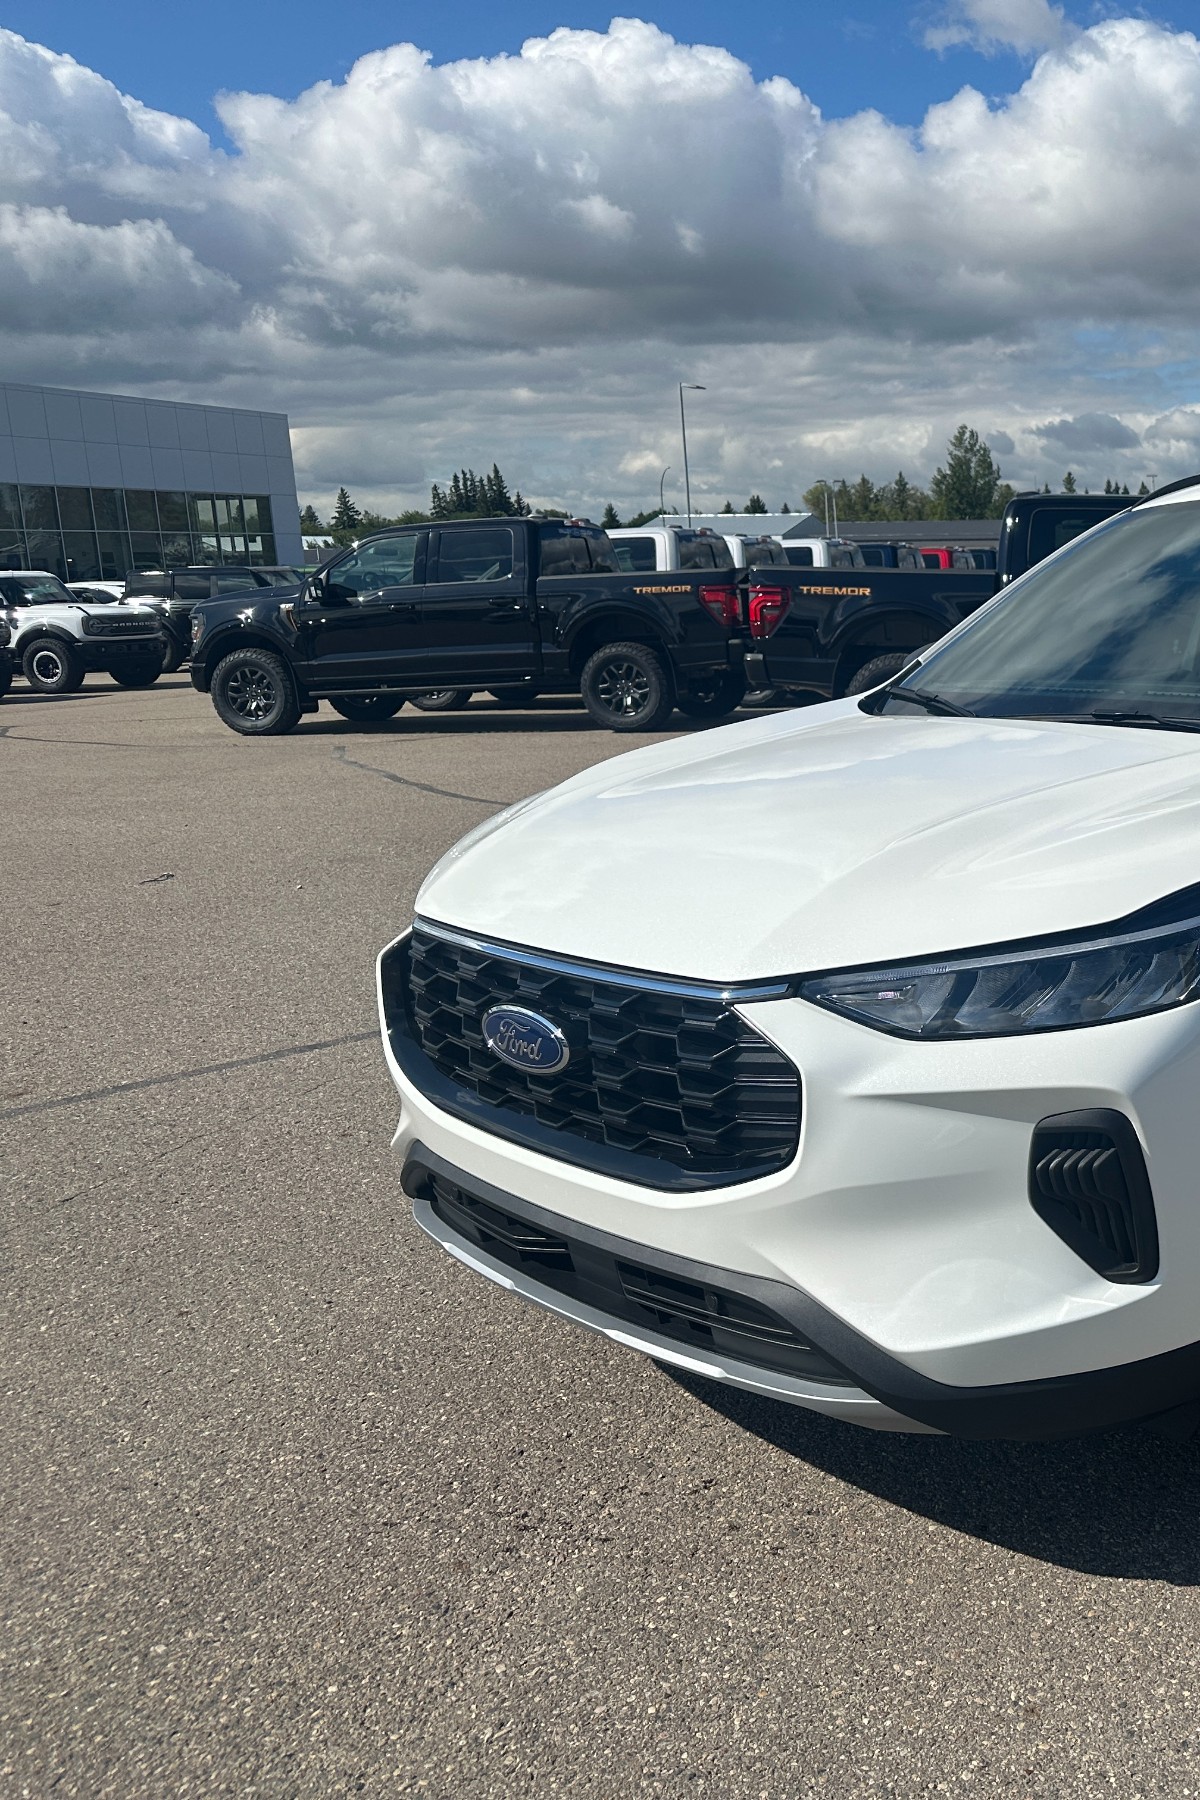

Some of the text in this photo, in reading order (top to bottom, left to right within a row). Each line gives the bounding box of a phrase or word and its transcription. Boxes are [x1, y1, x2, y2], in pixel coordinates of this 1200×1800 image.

[632, 585, 692, 594] TREMOR
[799, 585, 871, 596] TREMOR
[496, 1018, 542, 1060] Ford
